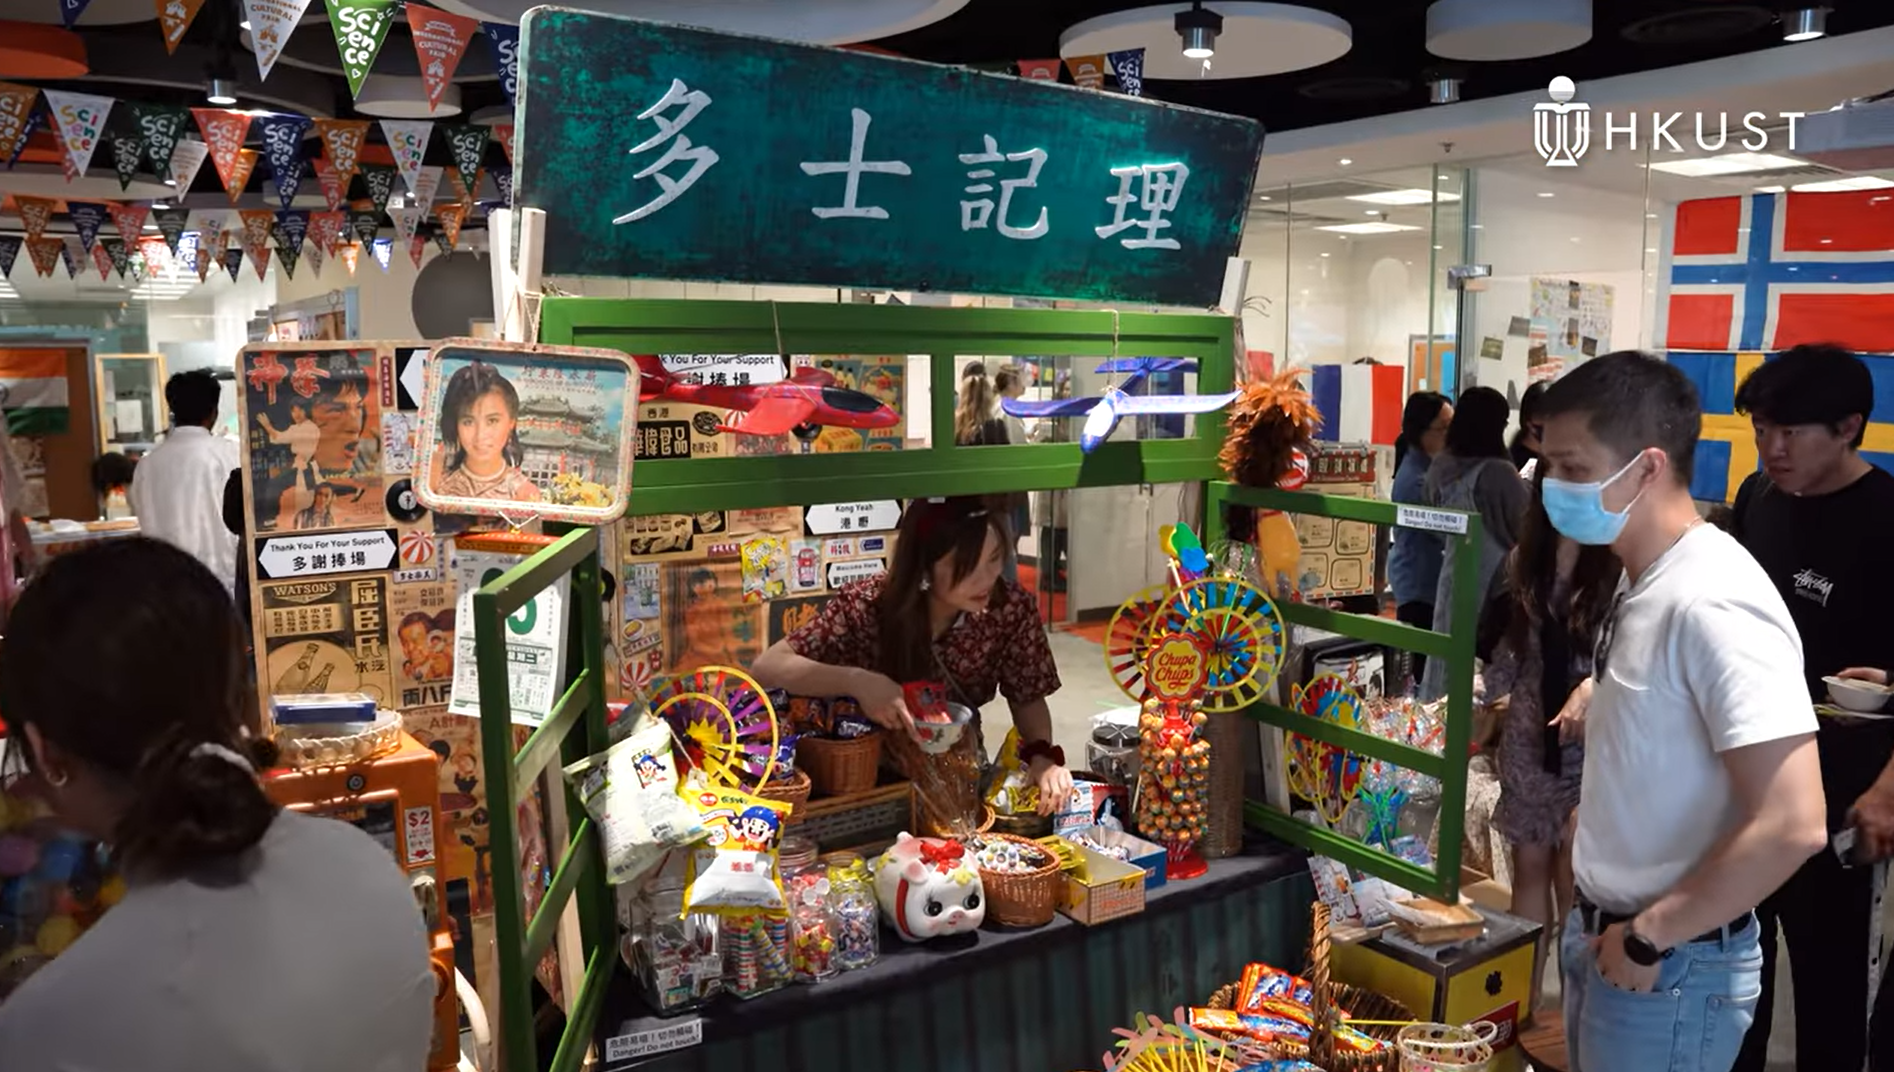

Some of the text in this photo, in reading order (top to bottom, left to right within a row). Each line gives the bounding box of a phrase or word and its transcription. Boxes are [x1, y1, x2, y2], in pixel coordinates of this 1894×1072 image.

[250, 4, 293, 21] CULTURAL
[338, 8, 386, 36] Sci
[348, 31, 376, 52] en
[418, 41, 457, 56] CULTURAL
[344, 47, 370, 66] ce
[1118, 61, 1140, 80] Sci
[1126, 77, 1141, 89] en
[60, 104, 98, 126] Sci
[70, 123, 96, 139] en
[141, 115, 178, 137] Sci
[207, 121, 241, 142] Sci
[264, 123, 298, 144] Sci
[69, 137, 91, 152] ce
[150, 133, 174, 149] en
[272, 140, 294, 156] en
[327, 129, 359, 150] Sci
[393, 131, 422, 151] Sci
[453, 134, 482, 154] Sci
[149, 146, 170, 160] ce
[271, 152, 290, 166] ce
[336, 146, 357, 160] en
[401, 147, 422, 161] en
[461, 149, 480, 163] en
[334, 159, 354, 171] ce
[401, 160, 419, 172] ce
[460, 161, 477, 174] ce
[671, 355, 689, 364] You
[692, 355, 707, 364] For
[711, 355, 733, 364] Your
[736, 355, 774, 366] Support
[835, 503, 874, 514] Kong Yeah
[271, 536, 386, 553] Thank You For Your Support
[292, 551, 366, 572] 多謝捧場
[1157, 652, 1197, 669] Chupa
[1155, 667, 1195, 689] Chups
[408, 810, 430, 828] $2
[612, 1033, 700, 1058] Danger! Do not touch!
